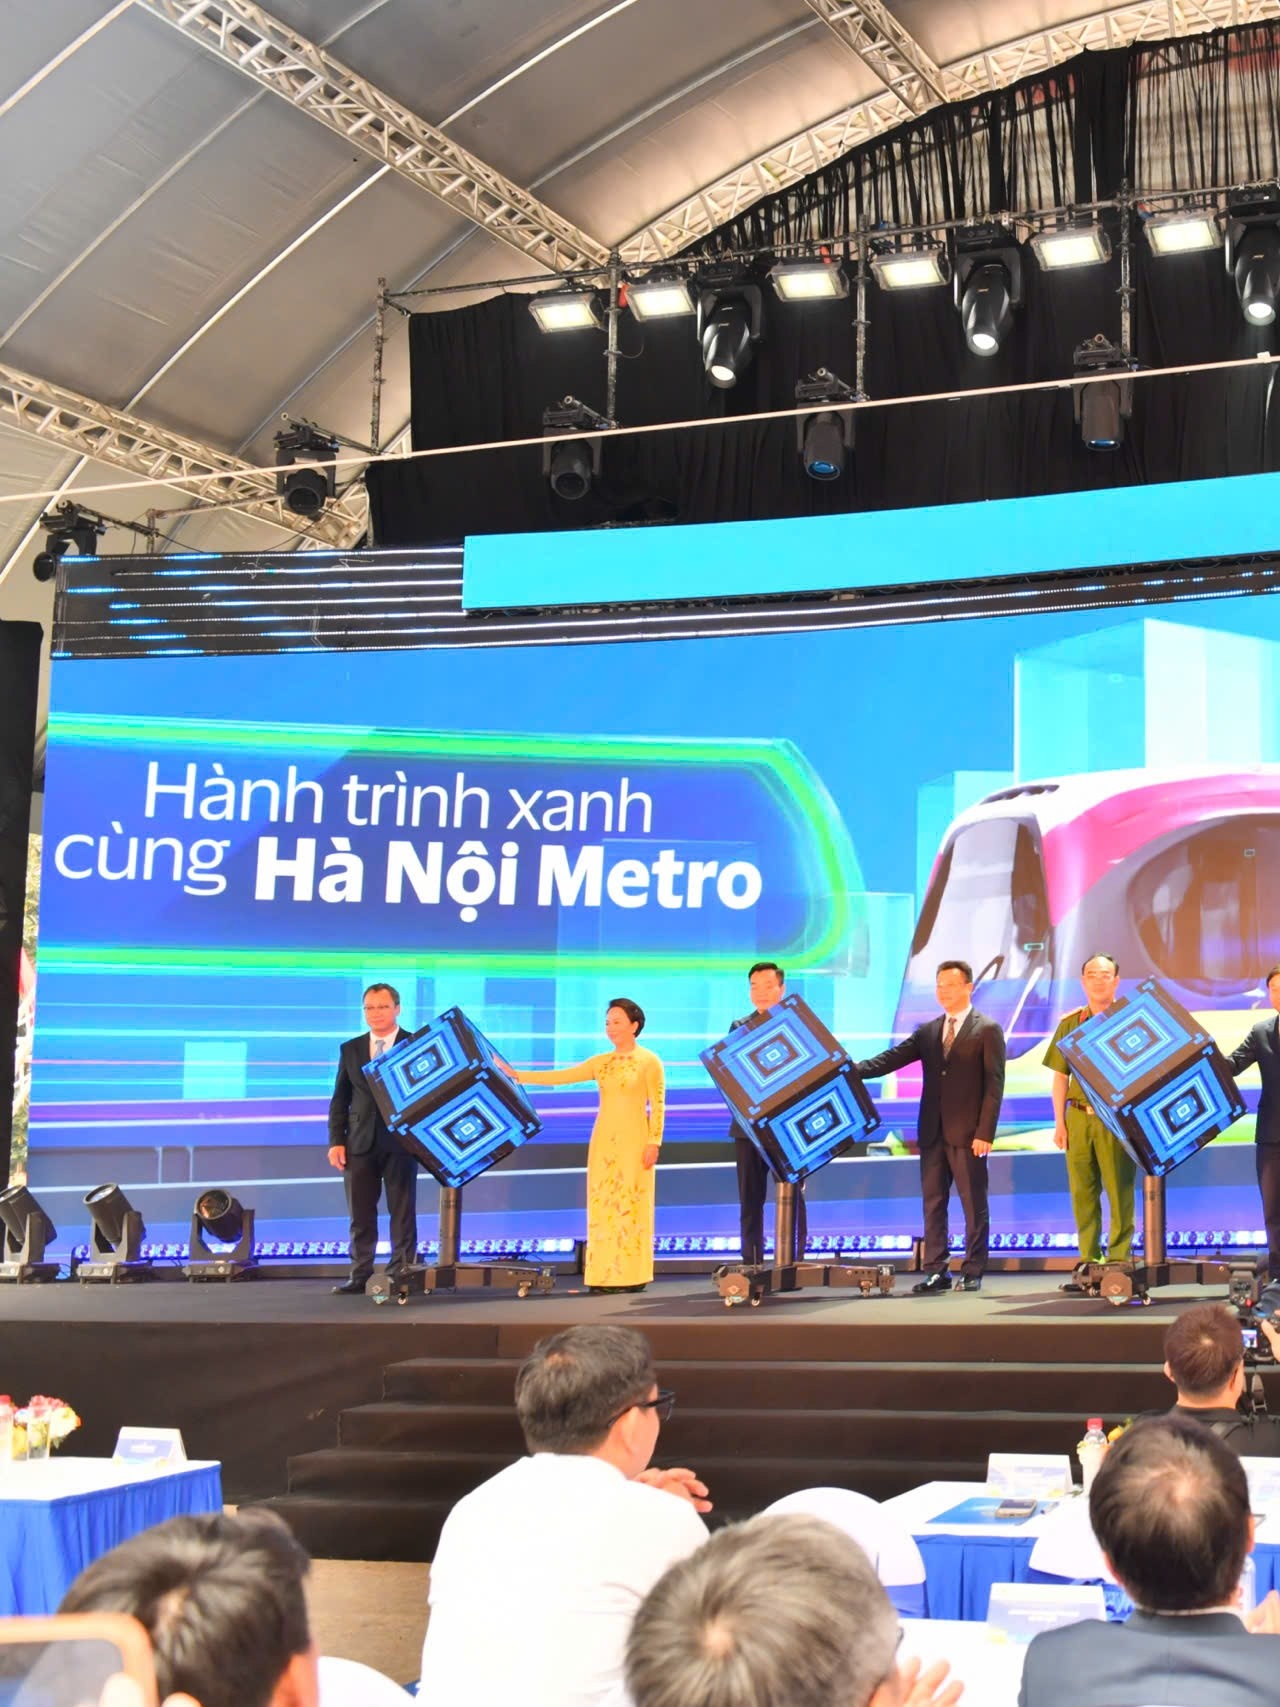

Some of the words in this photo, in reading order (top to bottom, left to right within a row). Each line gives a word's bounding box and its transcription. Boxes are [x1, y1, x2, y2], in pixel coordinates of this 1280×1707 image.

[144, 761, 325, 824] Hành
[342, 771, 490, 830] trình
[506, 777, 653, 833] xanh
[54, 821, 231, 896] cùng
[255, 836, 364, 903] Hà
[385, 840, 519, 923] Nội
[537, 844, 763, 910] Metro
